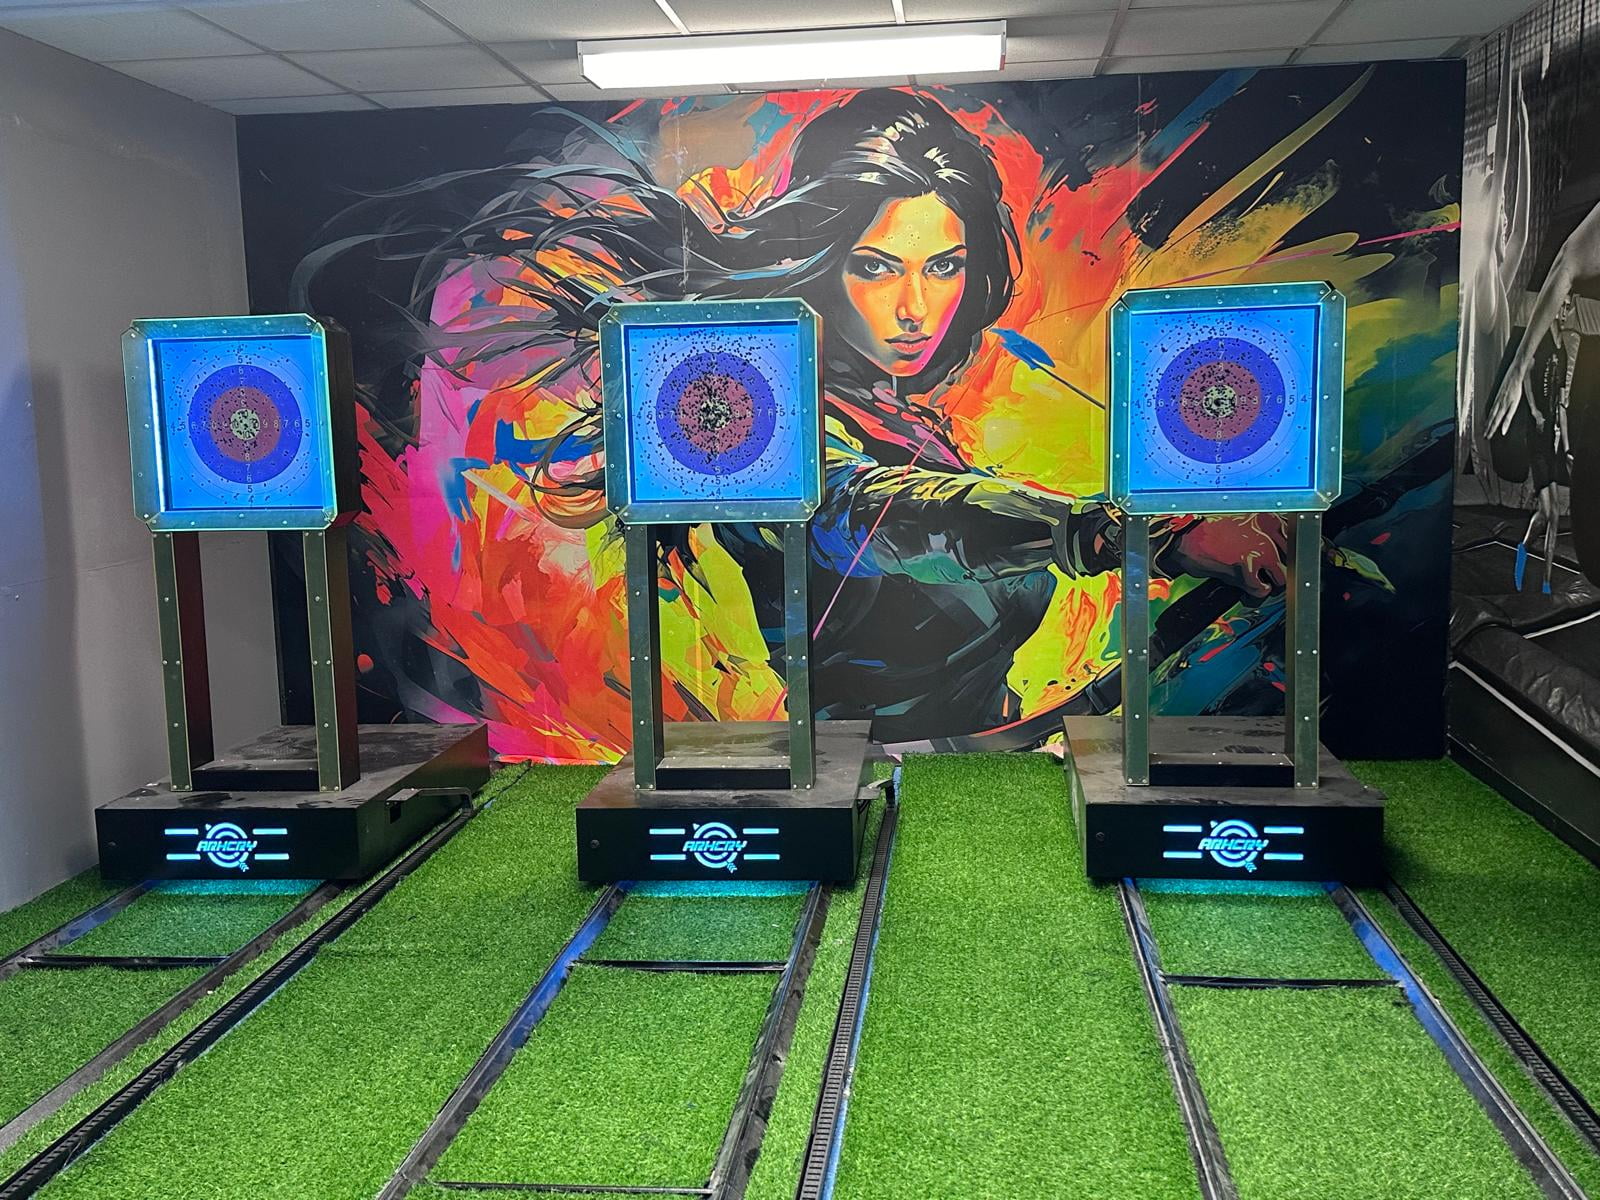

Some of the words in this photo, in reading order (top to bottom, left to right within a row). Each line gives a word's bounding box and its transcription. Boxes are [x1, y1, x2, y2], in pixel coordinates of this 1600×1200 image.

[710, 341, 717, 351] 5
[1146, 398, 1153, 408] 5
[1158, 398, 1165, 408] 6
[1264, 395, 1271, 405] 7
[1276, 394, 1283, 404] 6
[1288, 394, 1296, 405] 5
[273, 419, 279, 429] 8
[293, 419, 300, 428] 6
[305, 419, 312, 428] 5
[1215, 464, 1222, 474] 5
[247, 484, 254, 494] 5
